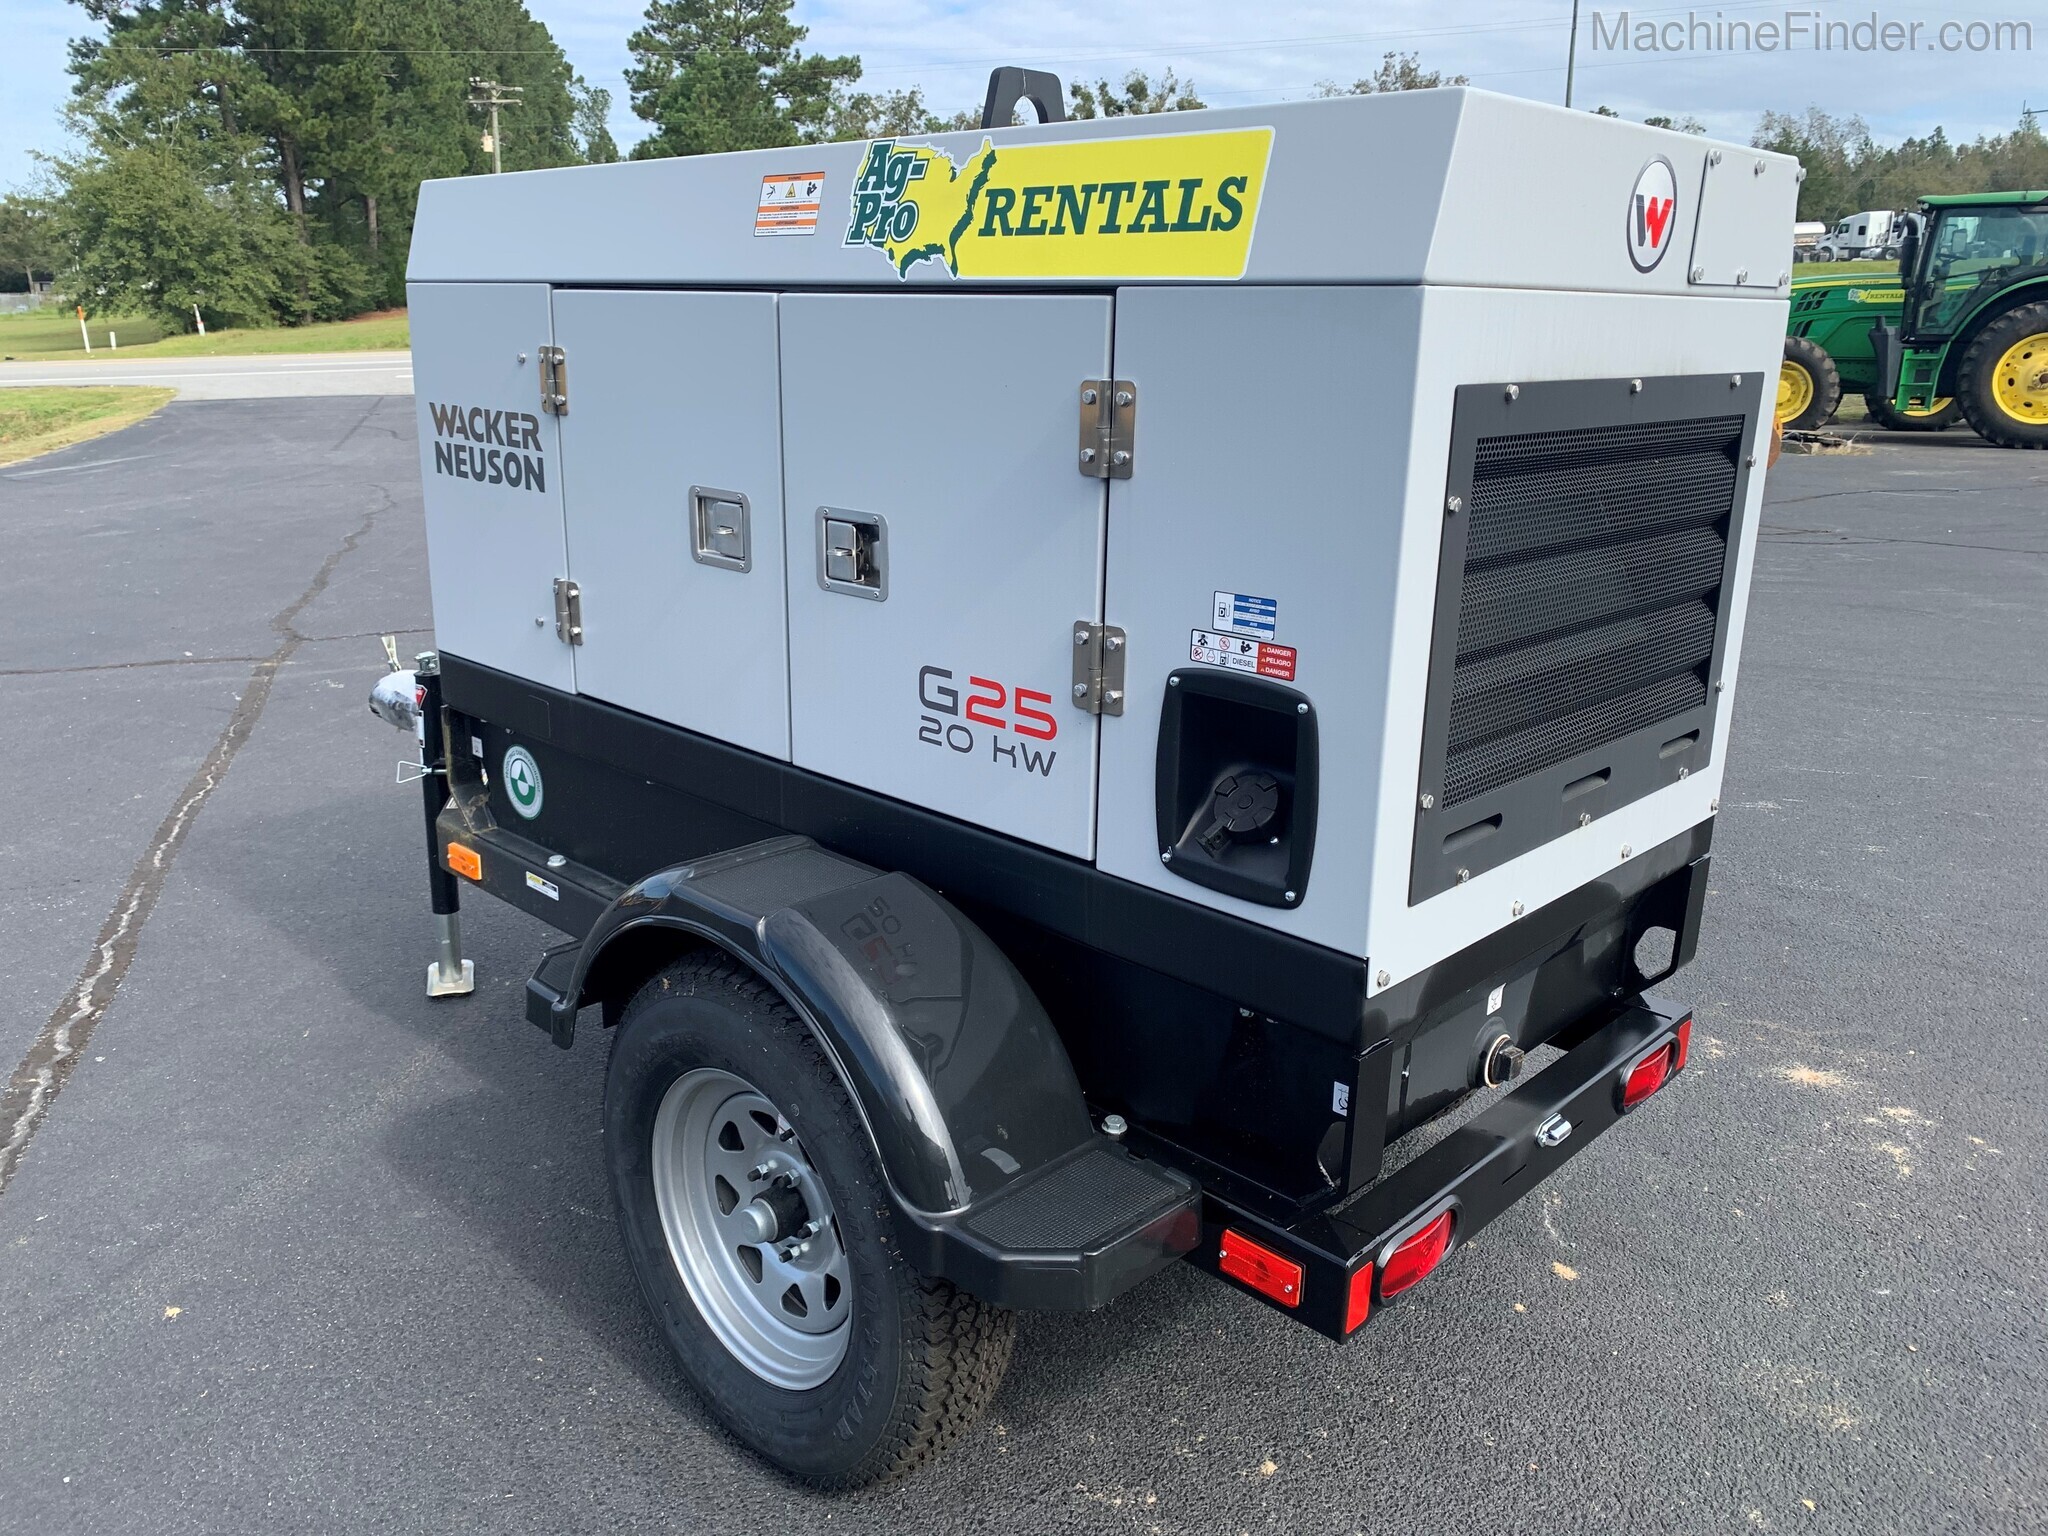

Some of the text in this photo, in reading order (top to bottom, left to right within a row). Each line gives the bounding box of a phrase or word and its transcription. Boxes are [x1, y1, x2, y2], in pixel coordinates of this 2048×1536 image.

[860, 138, 929, 192] Ag-
[850, 193, 918, 244] Pro
[978, 175, 1249, 238] RENTALS
[429, 402, 543, 452] WACKER
[434, 441, 545, 493] NEUSON
[1233, 658, 1255, 668] DIESEL
[1265, 657, 1292, 667] PELIGRO
[1265, 667, 1290, 677] DANGER
[1267, 647, 1291, 657] DANGER
[919, 665, 1057, 741] G25
[919, 715, 974, 753] 20
